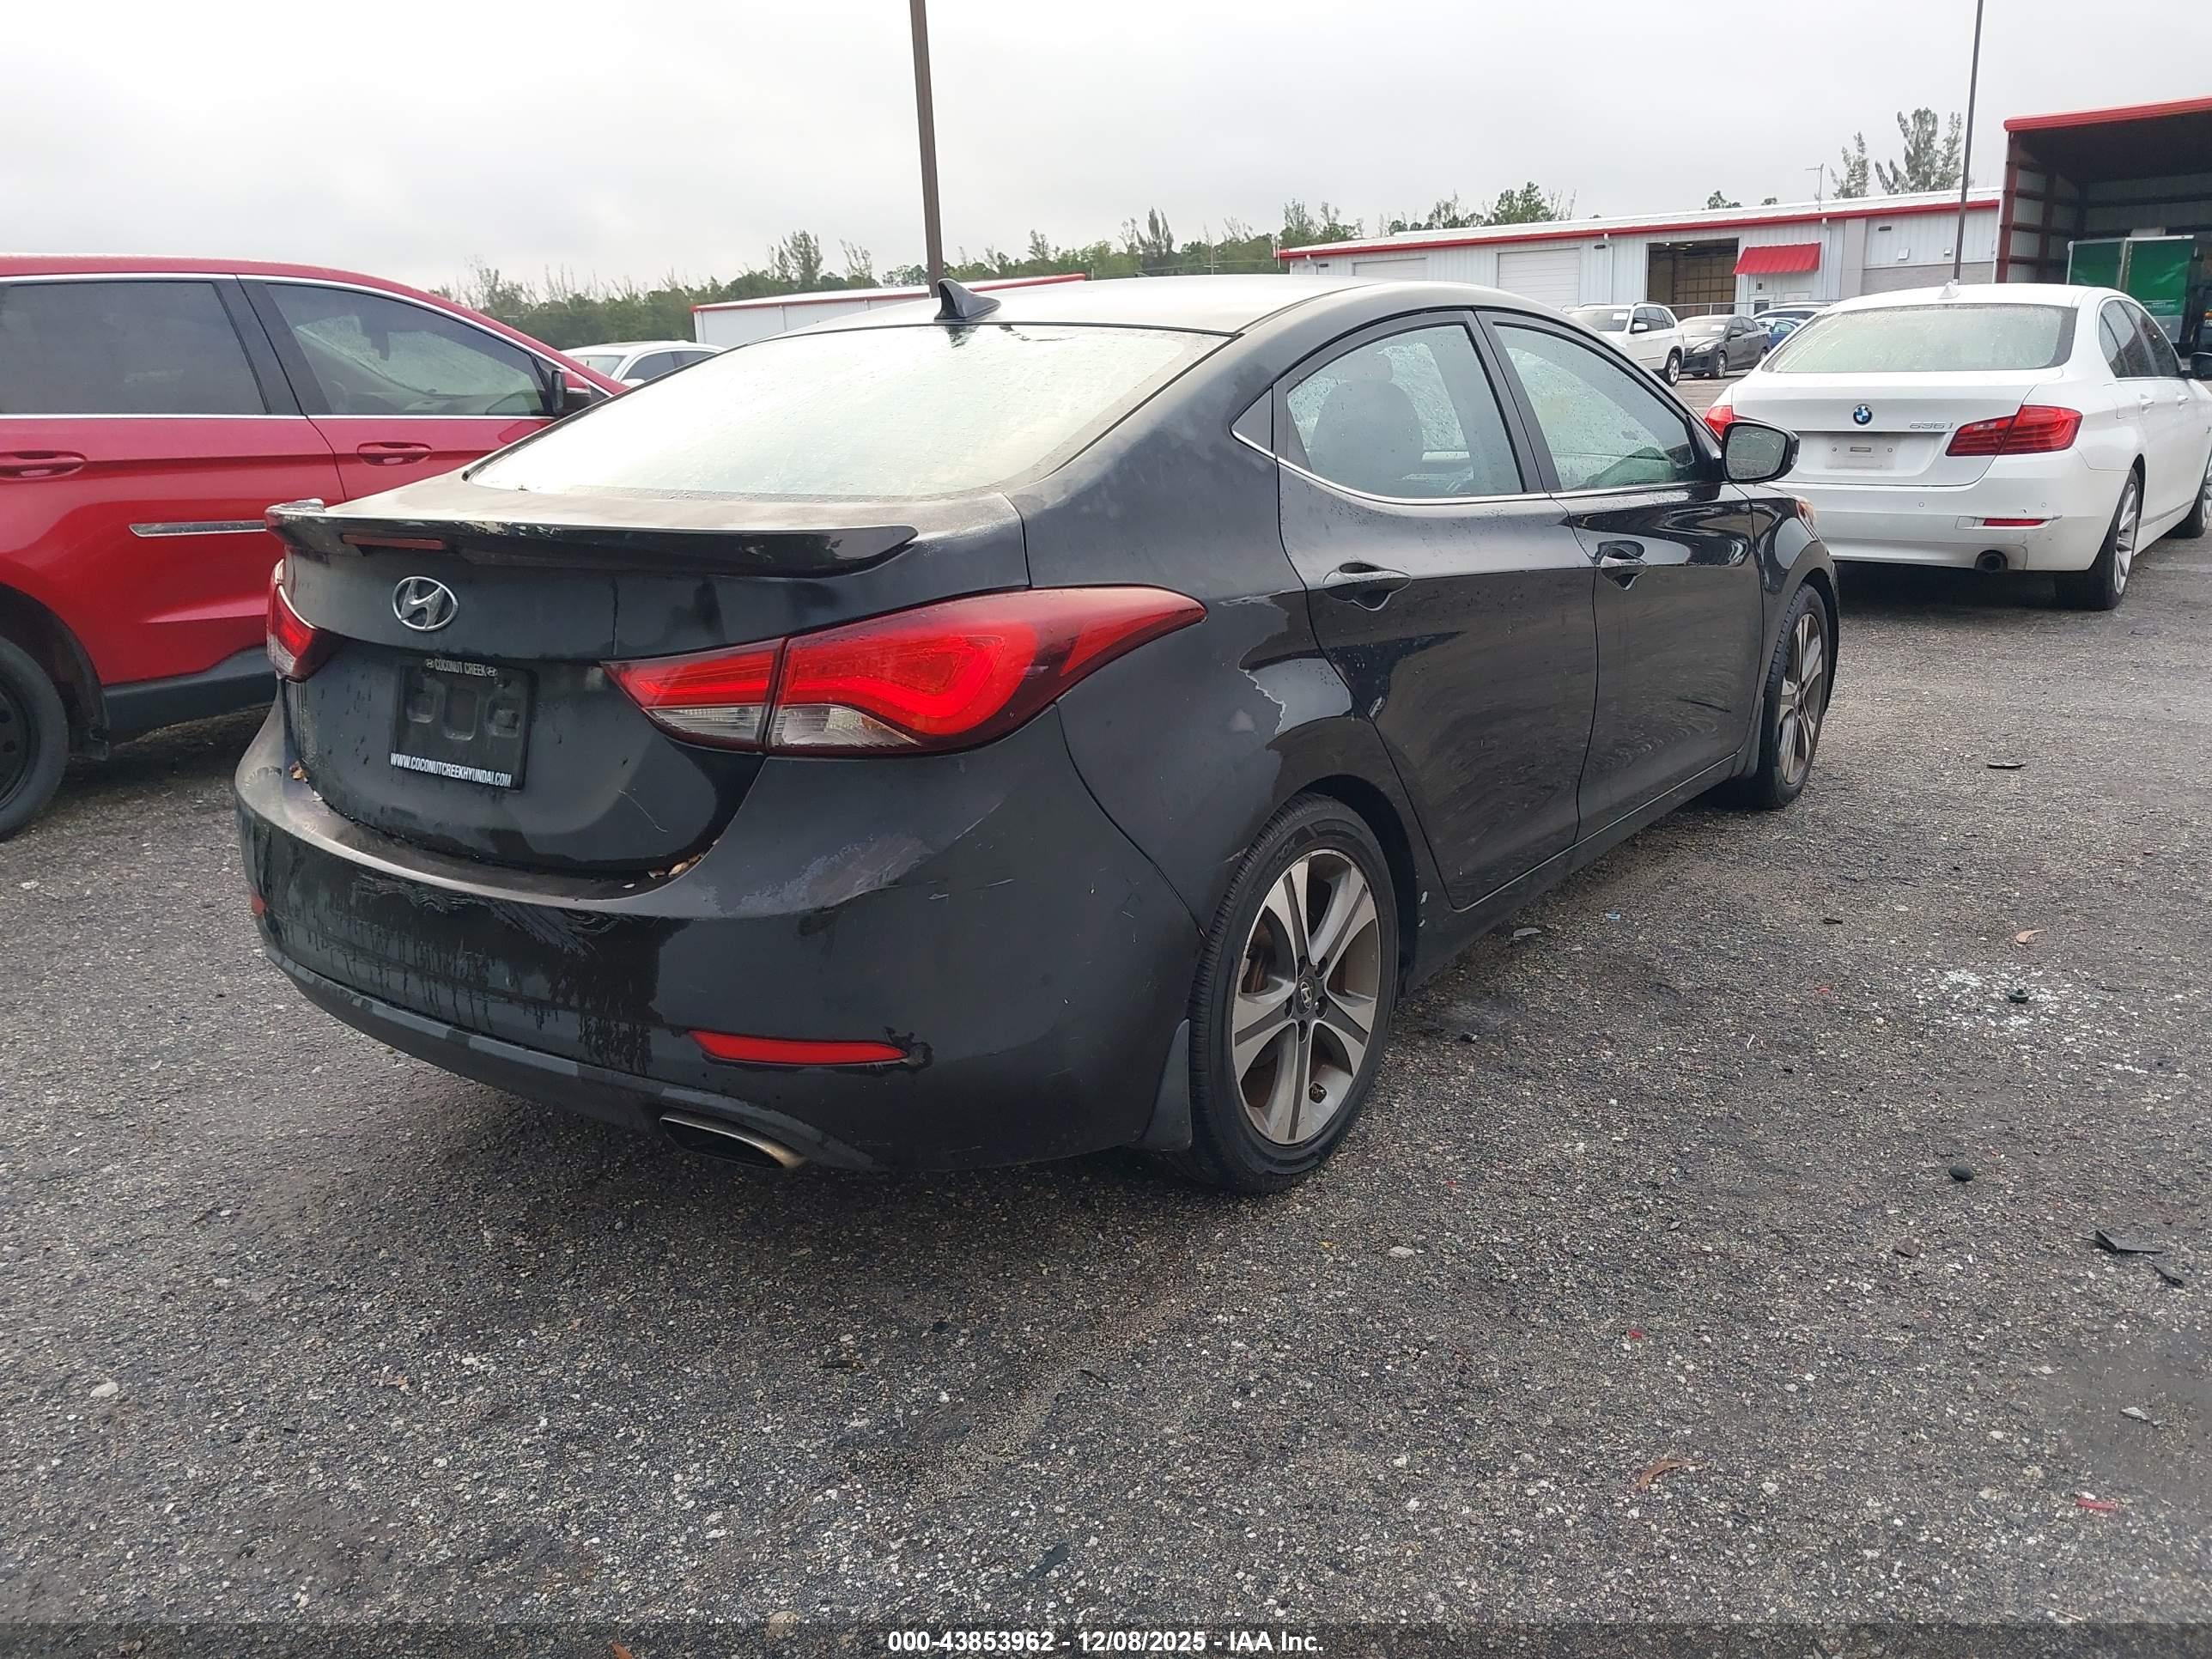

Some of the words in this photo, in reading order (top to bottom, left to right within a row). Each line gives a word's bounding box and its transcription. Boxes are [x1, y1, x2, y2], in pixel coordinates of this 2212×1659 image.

[434, 659, 463, 674] COCONUT
[464, 662, 487, 677] CREEK
[390, 752, 513, 787] WWW.COCONUTCREEKHYUNDAI.COM
